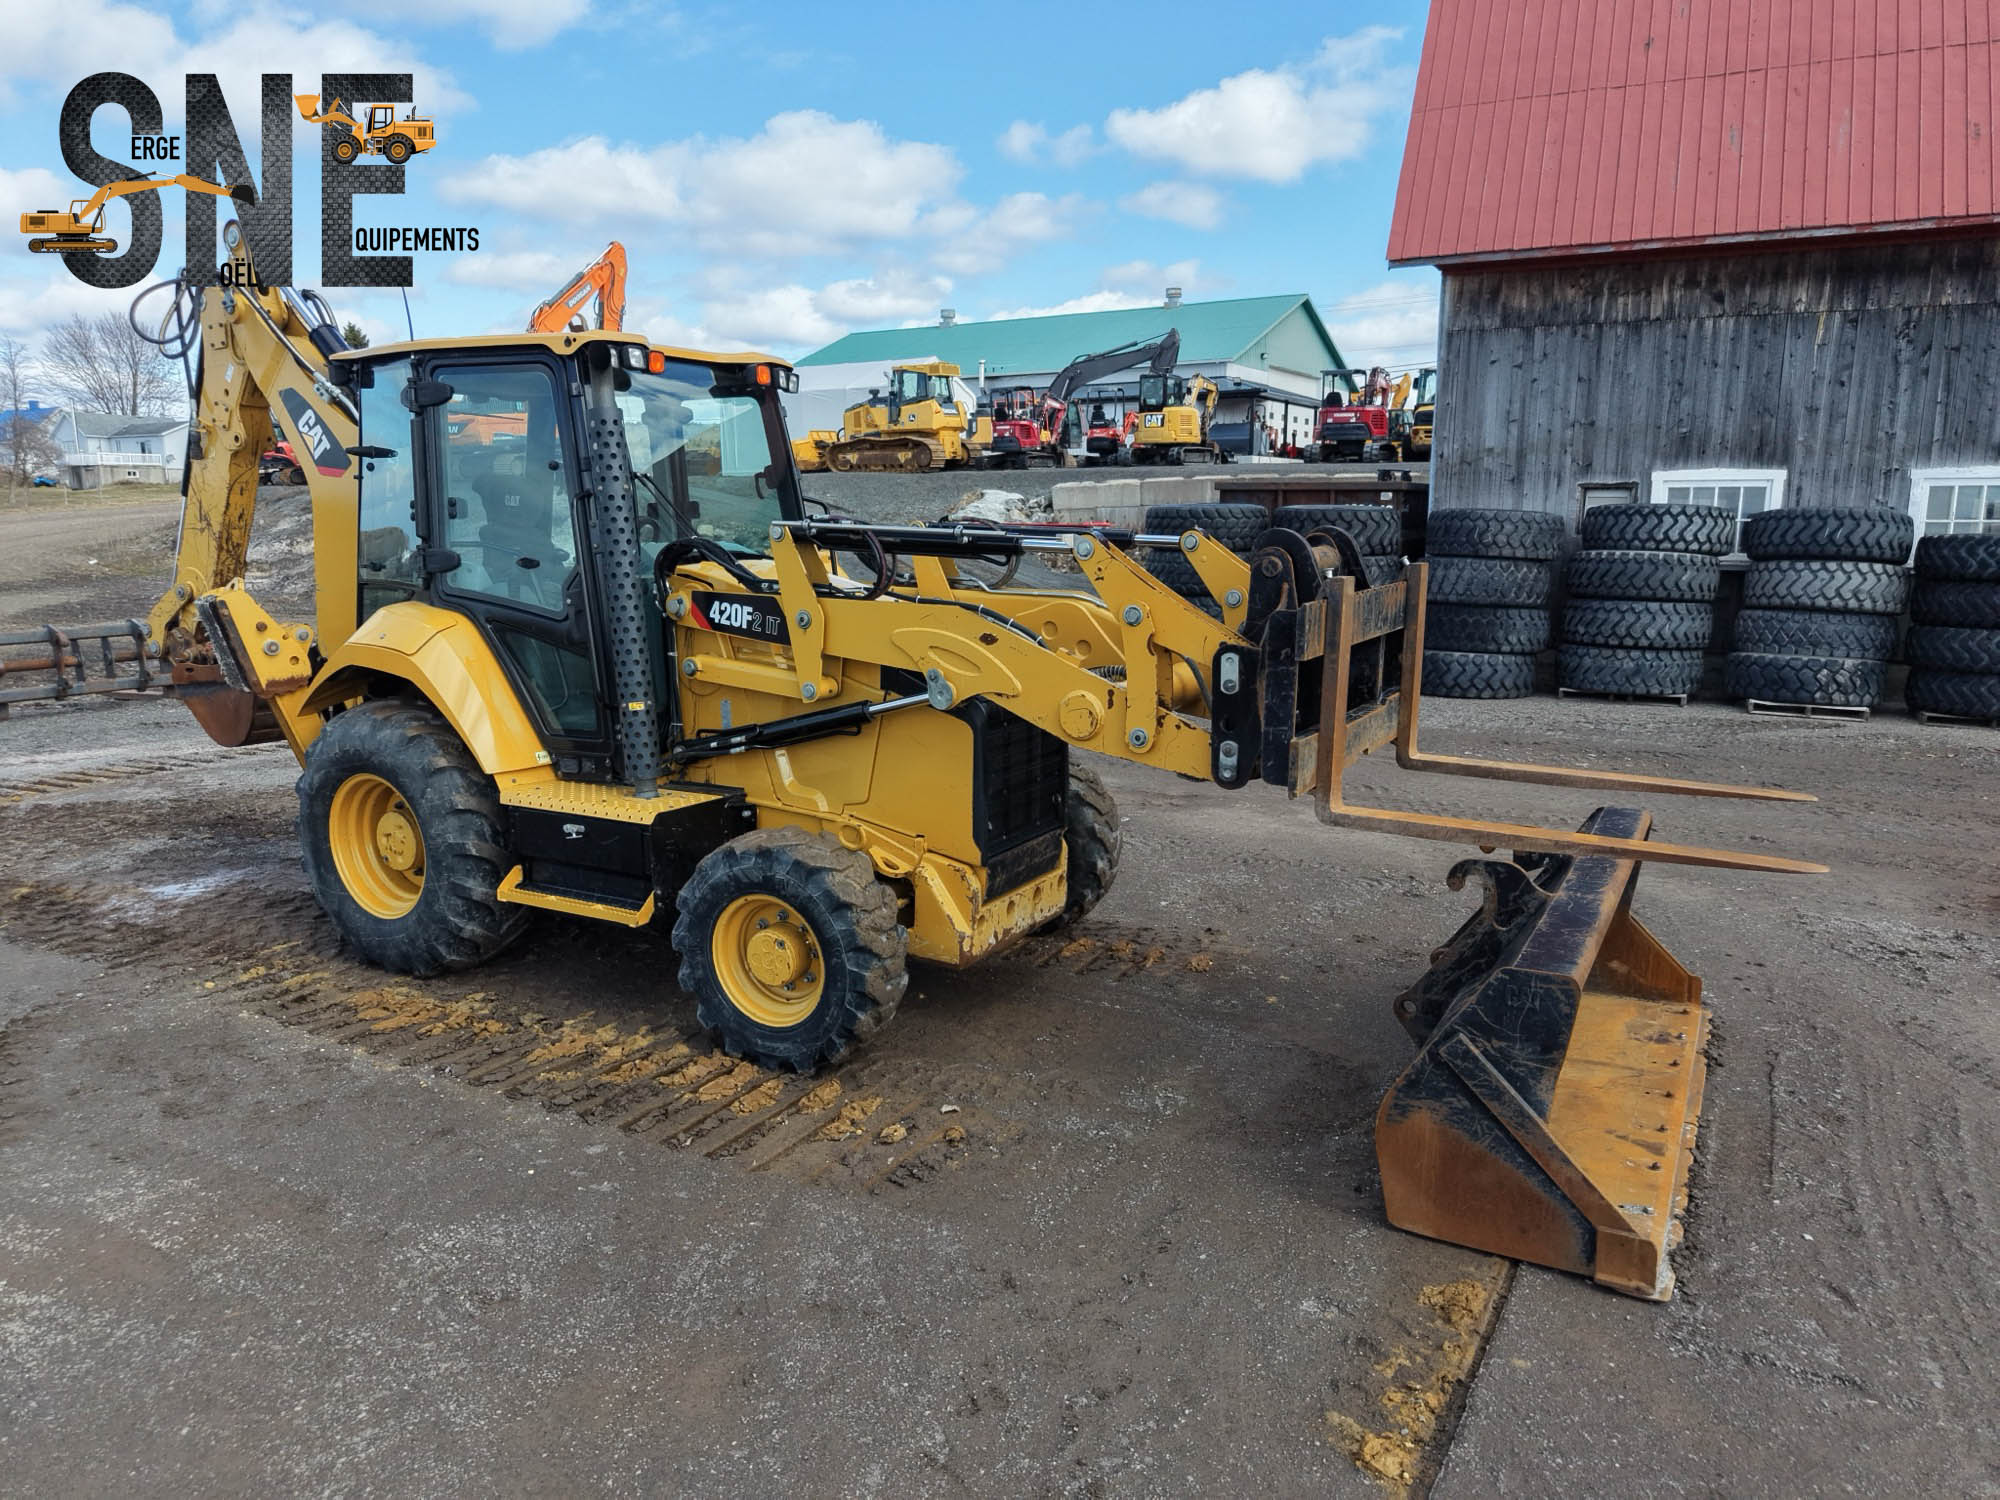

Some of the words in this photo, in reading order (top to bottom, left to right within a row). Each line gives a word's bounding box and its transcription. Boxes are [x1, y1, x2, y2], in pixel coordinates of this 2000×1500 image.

[1146, 415, 1163, 427] CAT
[298, 409, 330, 460] CAT
[766, 616, 780, 635] IT
